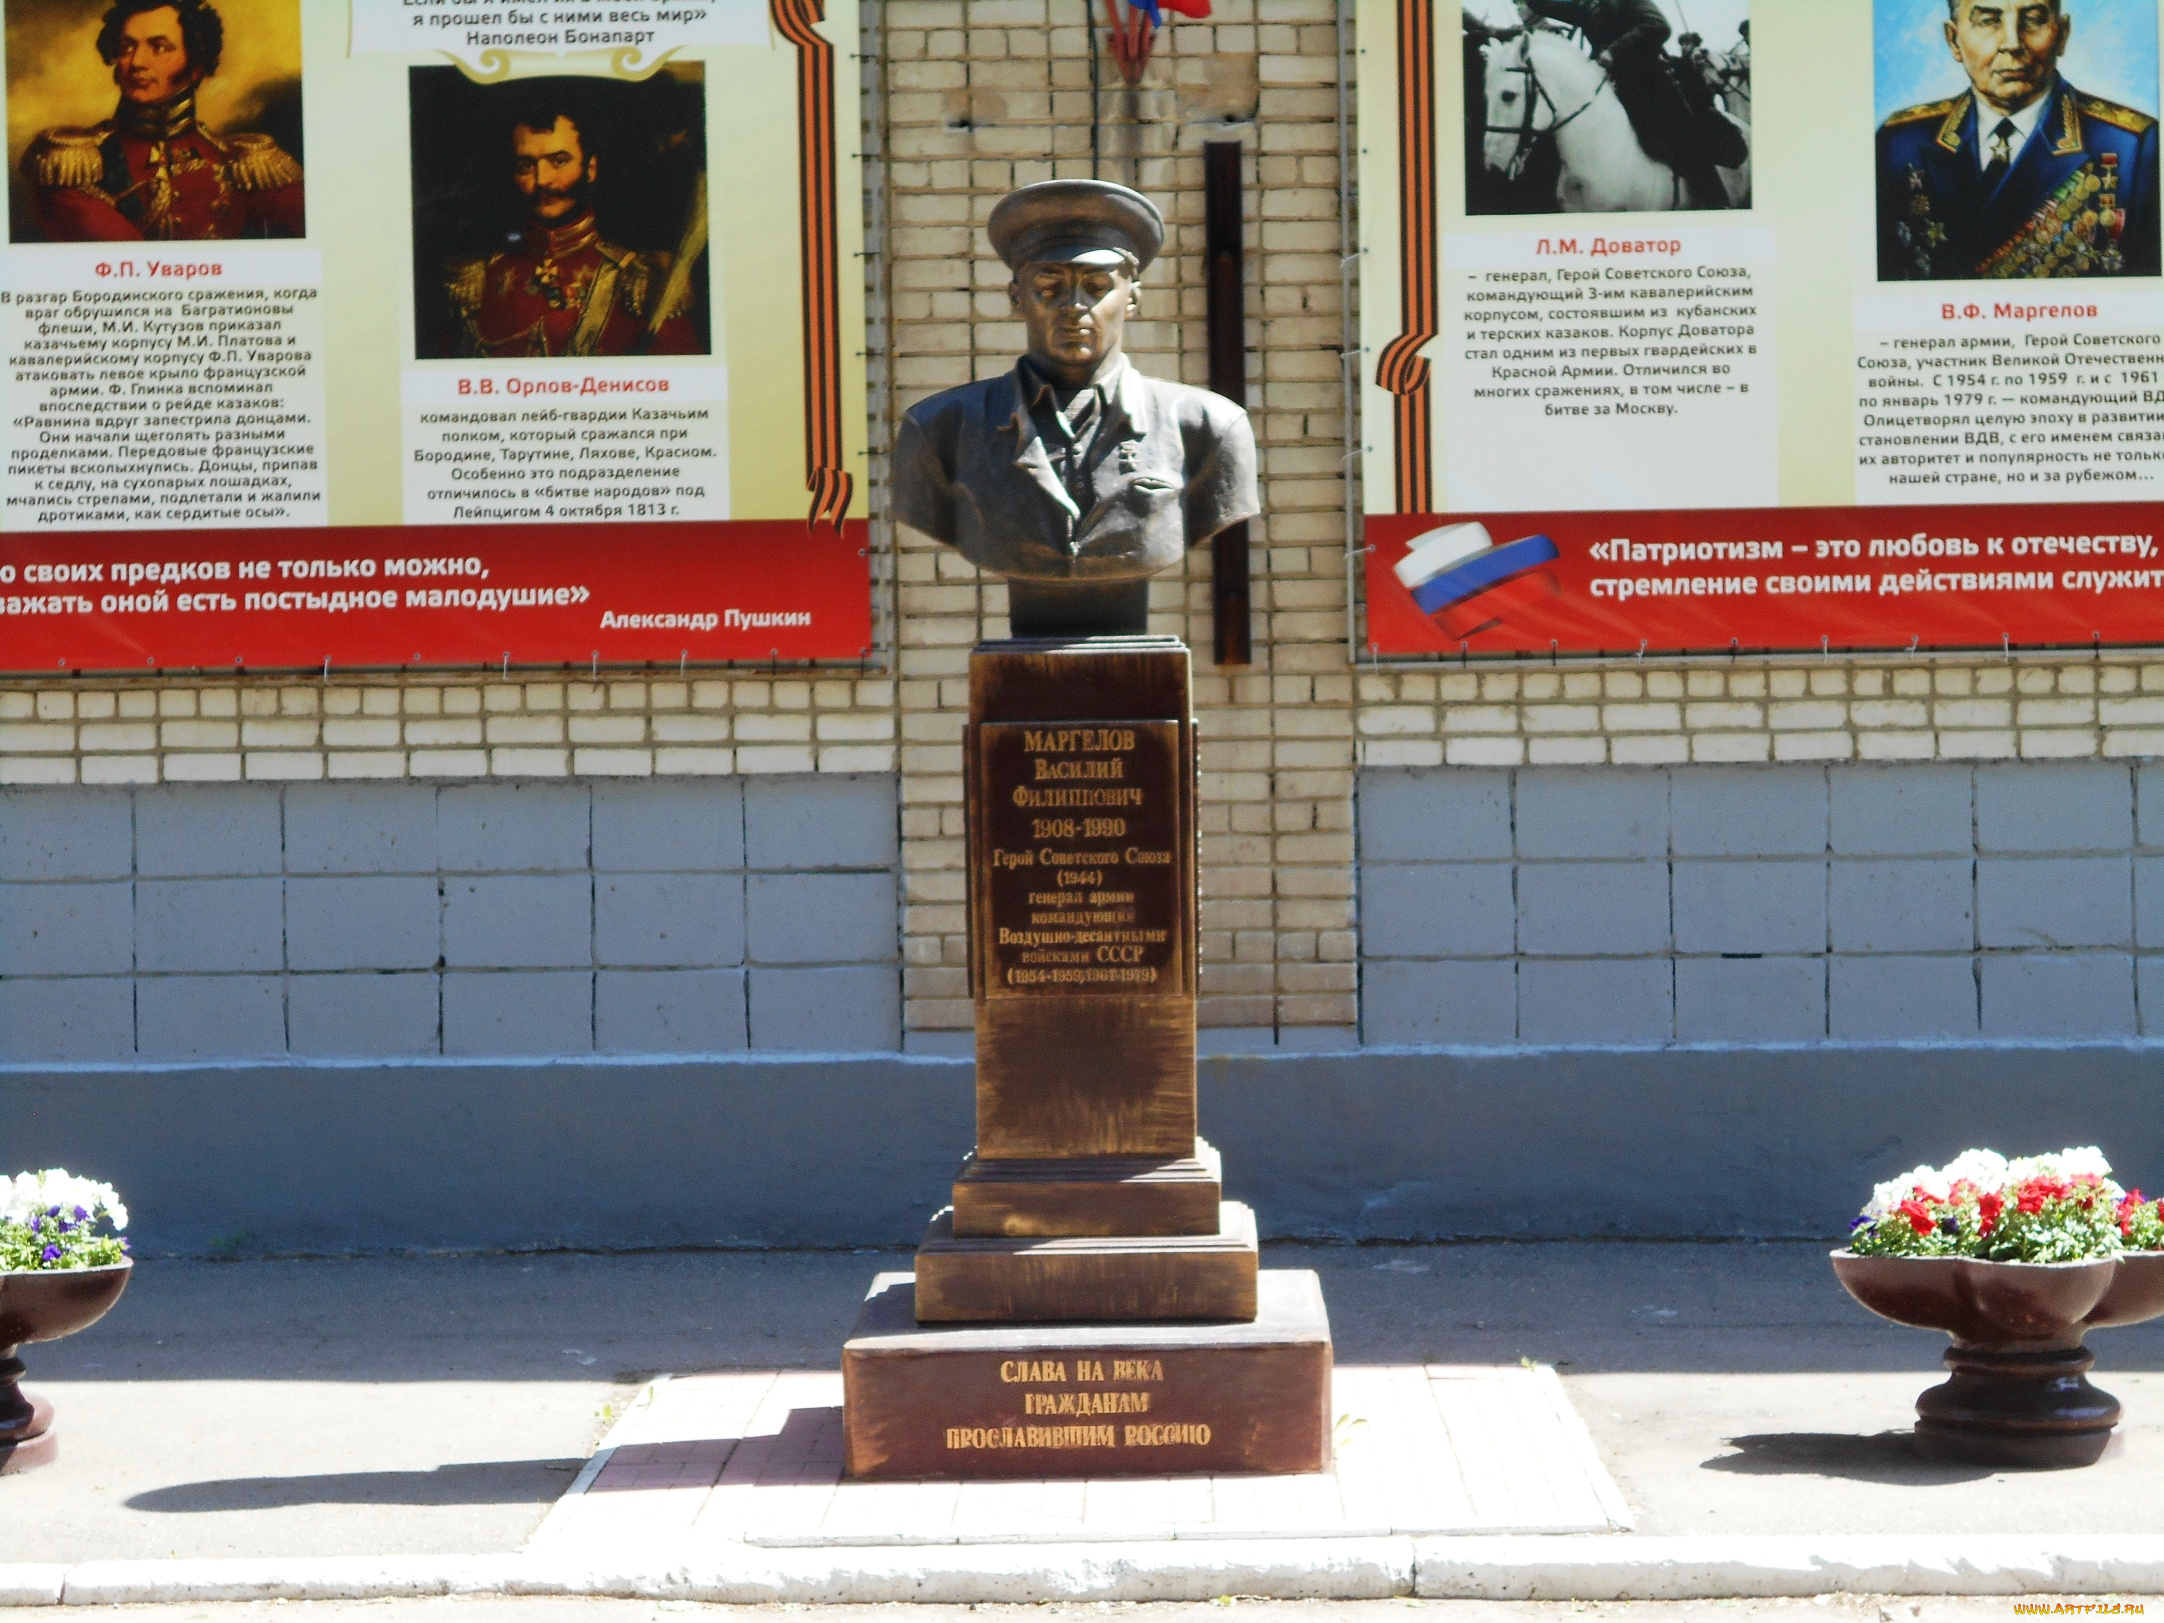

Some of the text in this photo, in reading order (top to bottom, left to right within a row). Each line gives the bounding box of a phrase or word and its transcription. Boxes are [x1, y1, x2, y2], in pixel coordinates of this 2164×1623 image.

[412, 8, 707, 29] я прошел бы с ними весь мир»
[466, 29, 656, 46] Наполеон Бонапарт
[1537, 237, 1681, 257] Л.М. Доватор
[95, 260, 222, 280] Ф.П. Уваров
[0, 288, 318, 306] В разгар Бородинского сражения, когда
[1466, 287, 1754, 303] командующий 3-им кавалерийским
[25, 304, 294, 321] враг обрушился на Багратионовы
[1464, 304, 1757, 323] корпусом, состоявшим из кубанских
[1942, 302, 2098, 322] В.Ф. Маргелов
[37, 320, 282, 337] флеши, М.И. Кутузов приказал
[1466, 324, 1755, 342] и терских казаков. Корпус Доватора
[1857, 356, 1912, 370] Союза,
[1916, 357, 1987, 371] участник
[1991, 353, 2060, 367] Великой
[15, 364, 306, 381] атаковать левое крыло французской
[1492, 363, 1731, 381] Красной Армии. Отличился во
[458, 376, 669, 397] В.В. Орлов-Денисов
[39, 398, 284, 413] впоследствии о рейде казаков:
[1544, 402, 1678, 416] битве за Москву.
[420, 407, 709, 425] командовал лейб-гвардии Казачьим
[1863, 414, 1971, 428] Олицетворял
[1974, 414, 2026, 427] целую
[2030, 413, 2074, 426] эпоху
[2078, 413, 2087, 423] в
[39, 429, 285, 444] Они начали щеголять разными
[442, 428, 688, 443] полком, который сражался при
[1858, 431, 2164, 446] становлении ВДВ, с его именем связа
[414, 446, 717, 464] Бородине, Тарутине, Ляхове, Красном.
[8, 459, 318, 475] пикеты всколыхнулись. Донцы, припав
[1889, 471, 1941, 484] нашей
[1944, 473, 2002, 485] стране,
[2006, 472, 2026, 482] но
[2030, 473, 2039, 482] и
[2044, 471, 2061, 482] за
[37, 507, 290, 524] дротиками, как сердитые осы».
[453, 503, 680, 520] Лейпцигом 4 октября 1813 г.
[1590, 538, 1783, 566] «Патриотизм
[1816, 539, 1860, 558] это
[1869, 532, 1979, 558] любовь
[1987, 537, 2004, 555] к
[2012, 535, 2158, 558] отечеству,
[24, 563, 103, 583] своих
[111, 561, 230, 587] предков
[239, 560, 271, 579] не
[278, 559, 376, 579] только
[385, 557, 489, 580] можно,
[1590, 576, 1757, 602] стремление
[1766, 574, 1871, 595] своими
[1879, 568, 2053, 596] действиями
[101, 589, 168, 613] оной
[177, 592, 237, 612] есть
[245, 589, 398, 613] постыдное
[406, 585, 590, 611] малодушие»
[600, 608, 811, 632] Александр Пушкин
[1024, 728, 1135, 752] МАРГЕЛОВ
[1032, 817, 1126, 839] 1908-1990
[993, 848, 1034, 870] Герой
[1057, 868, 1102, 888] (1944)
[1096, 944, 1144, 963] СССР
[1001, 1359, 1163, 1383] СЛАВА НА ВЕКА
[1025, 1391, 1149, 1417] ГРАЖДАНАМ
[947, 1422, 1211, 1449] ПРОСЛАВИВШИМ РОССИЮ
